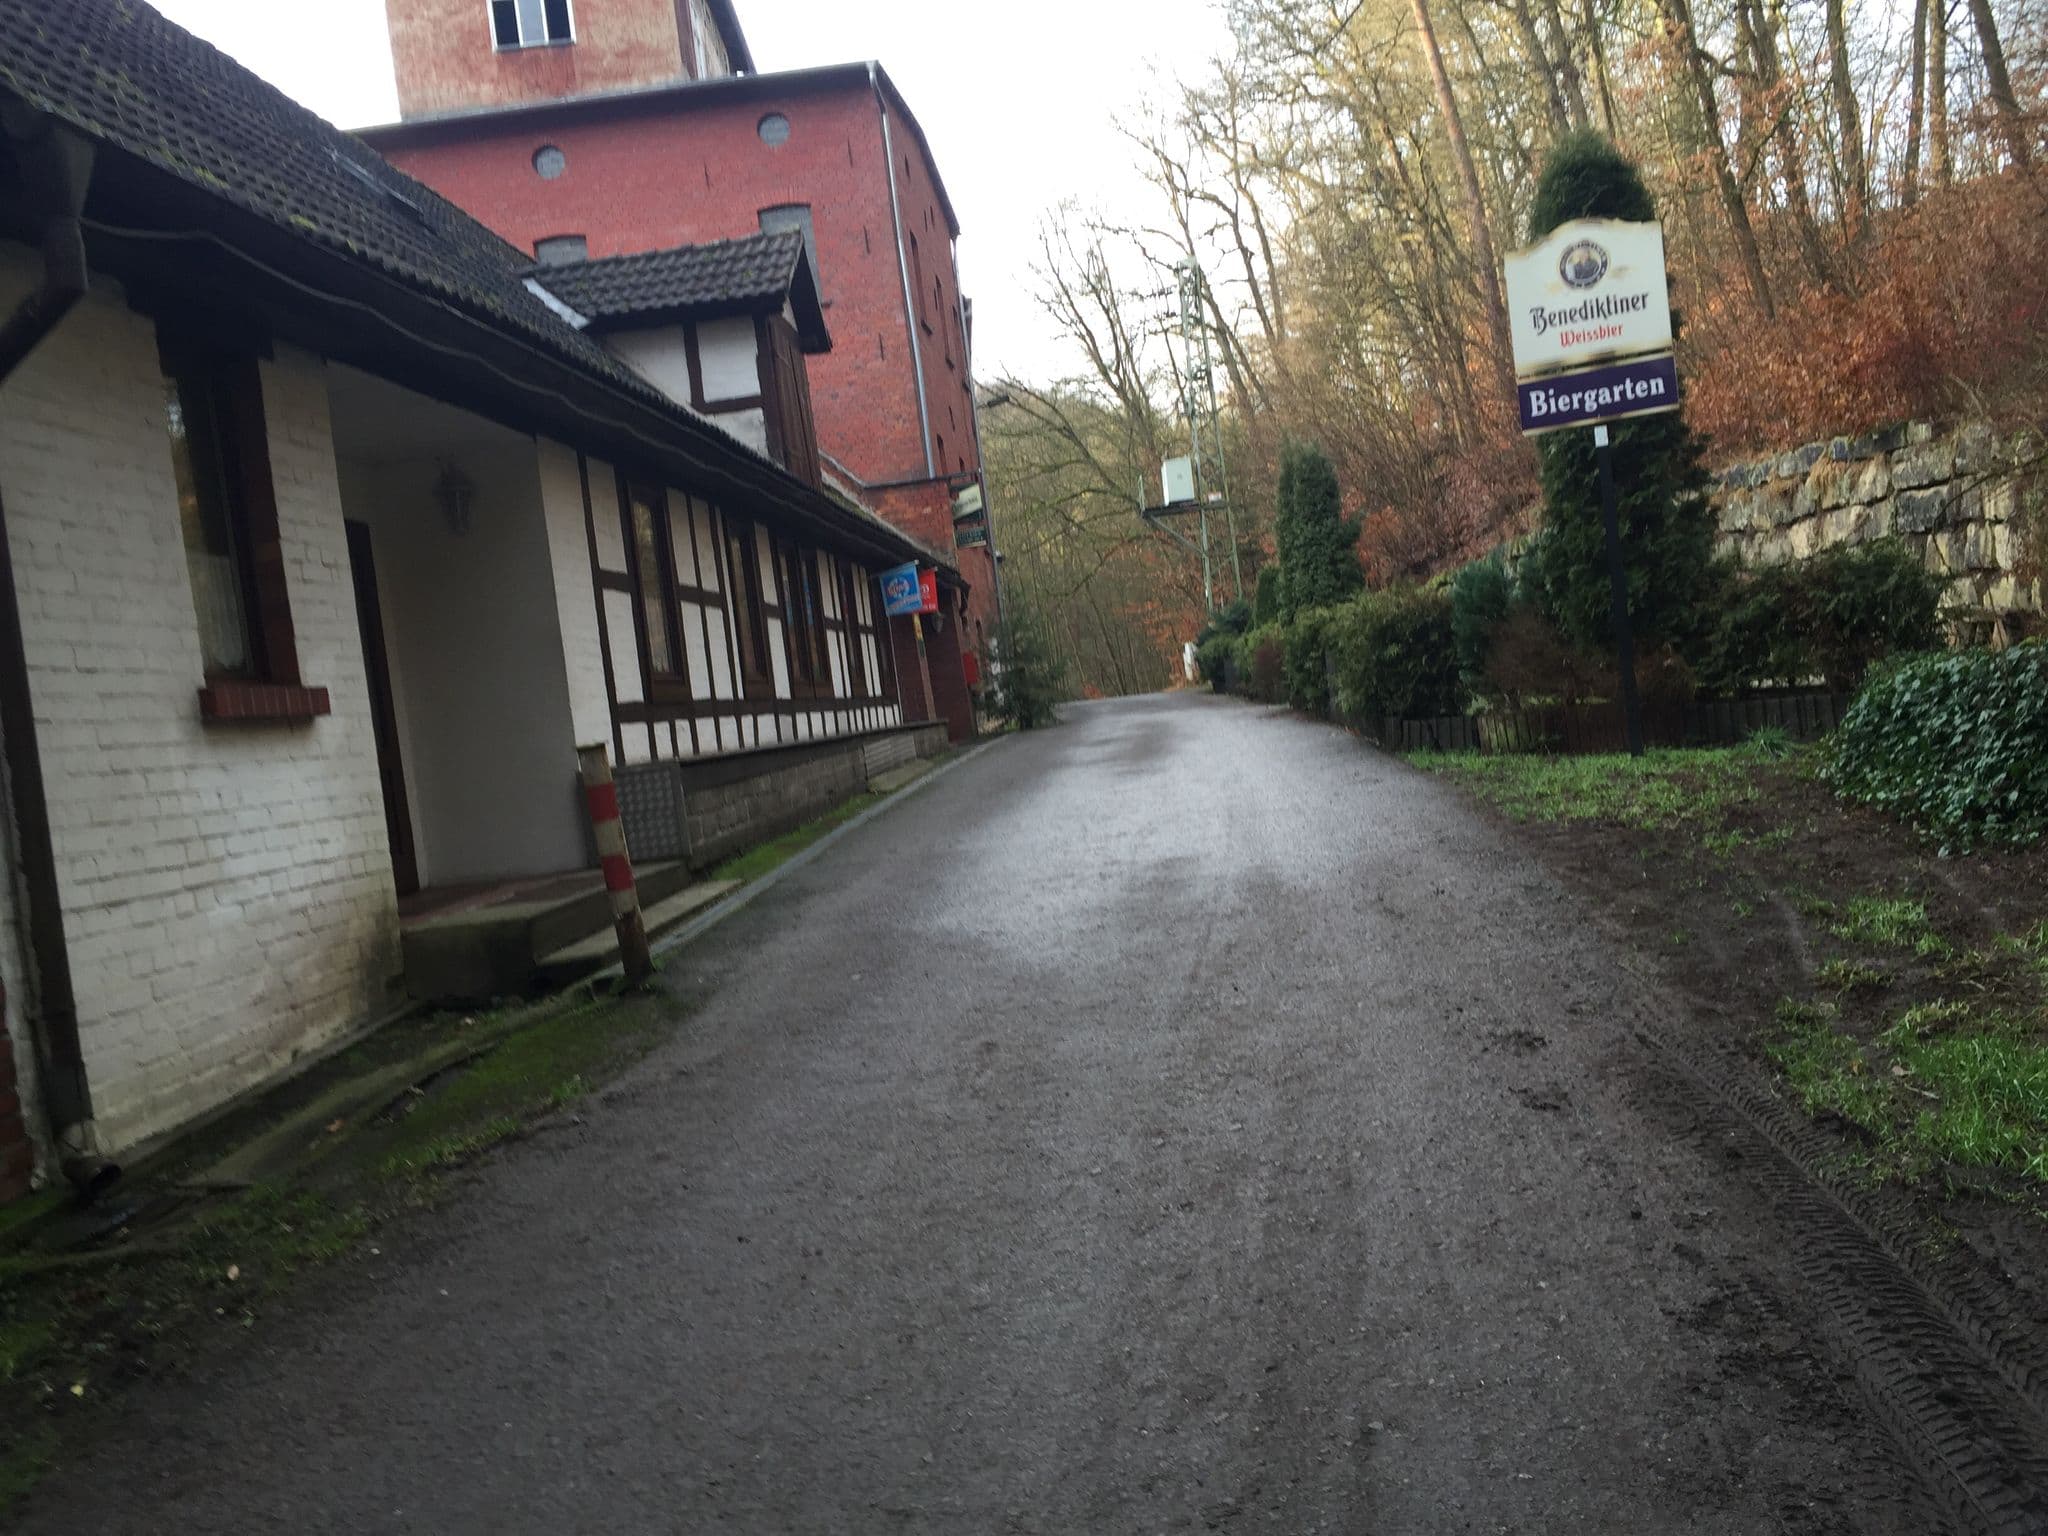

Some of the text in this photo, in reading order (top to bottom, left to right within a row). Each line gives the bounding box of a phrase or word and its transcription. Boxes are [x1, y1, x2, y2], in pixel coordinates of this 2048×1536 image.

[1529, 293, 1649, 336] Benediktiner
[1560, 324, 1624, 348] Weissbier
[1529, 376, 1666, 418] Biergarten
